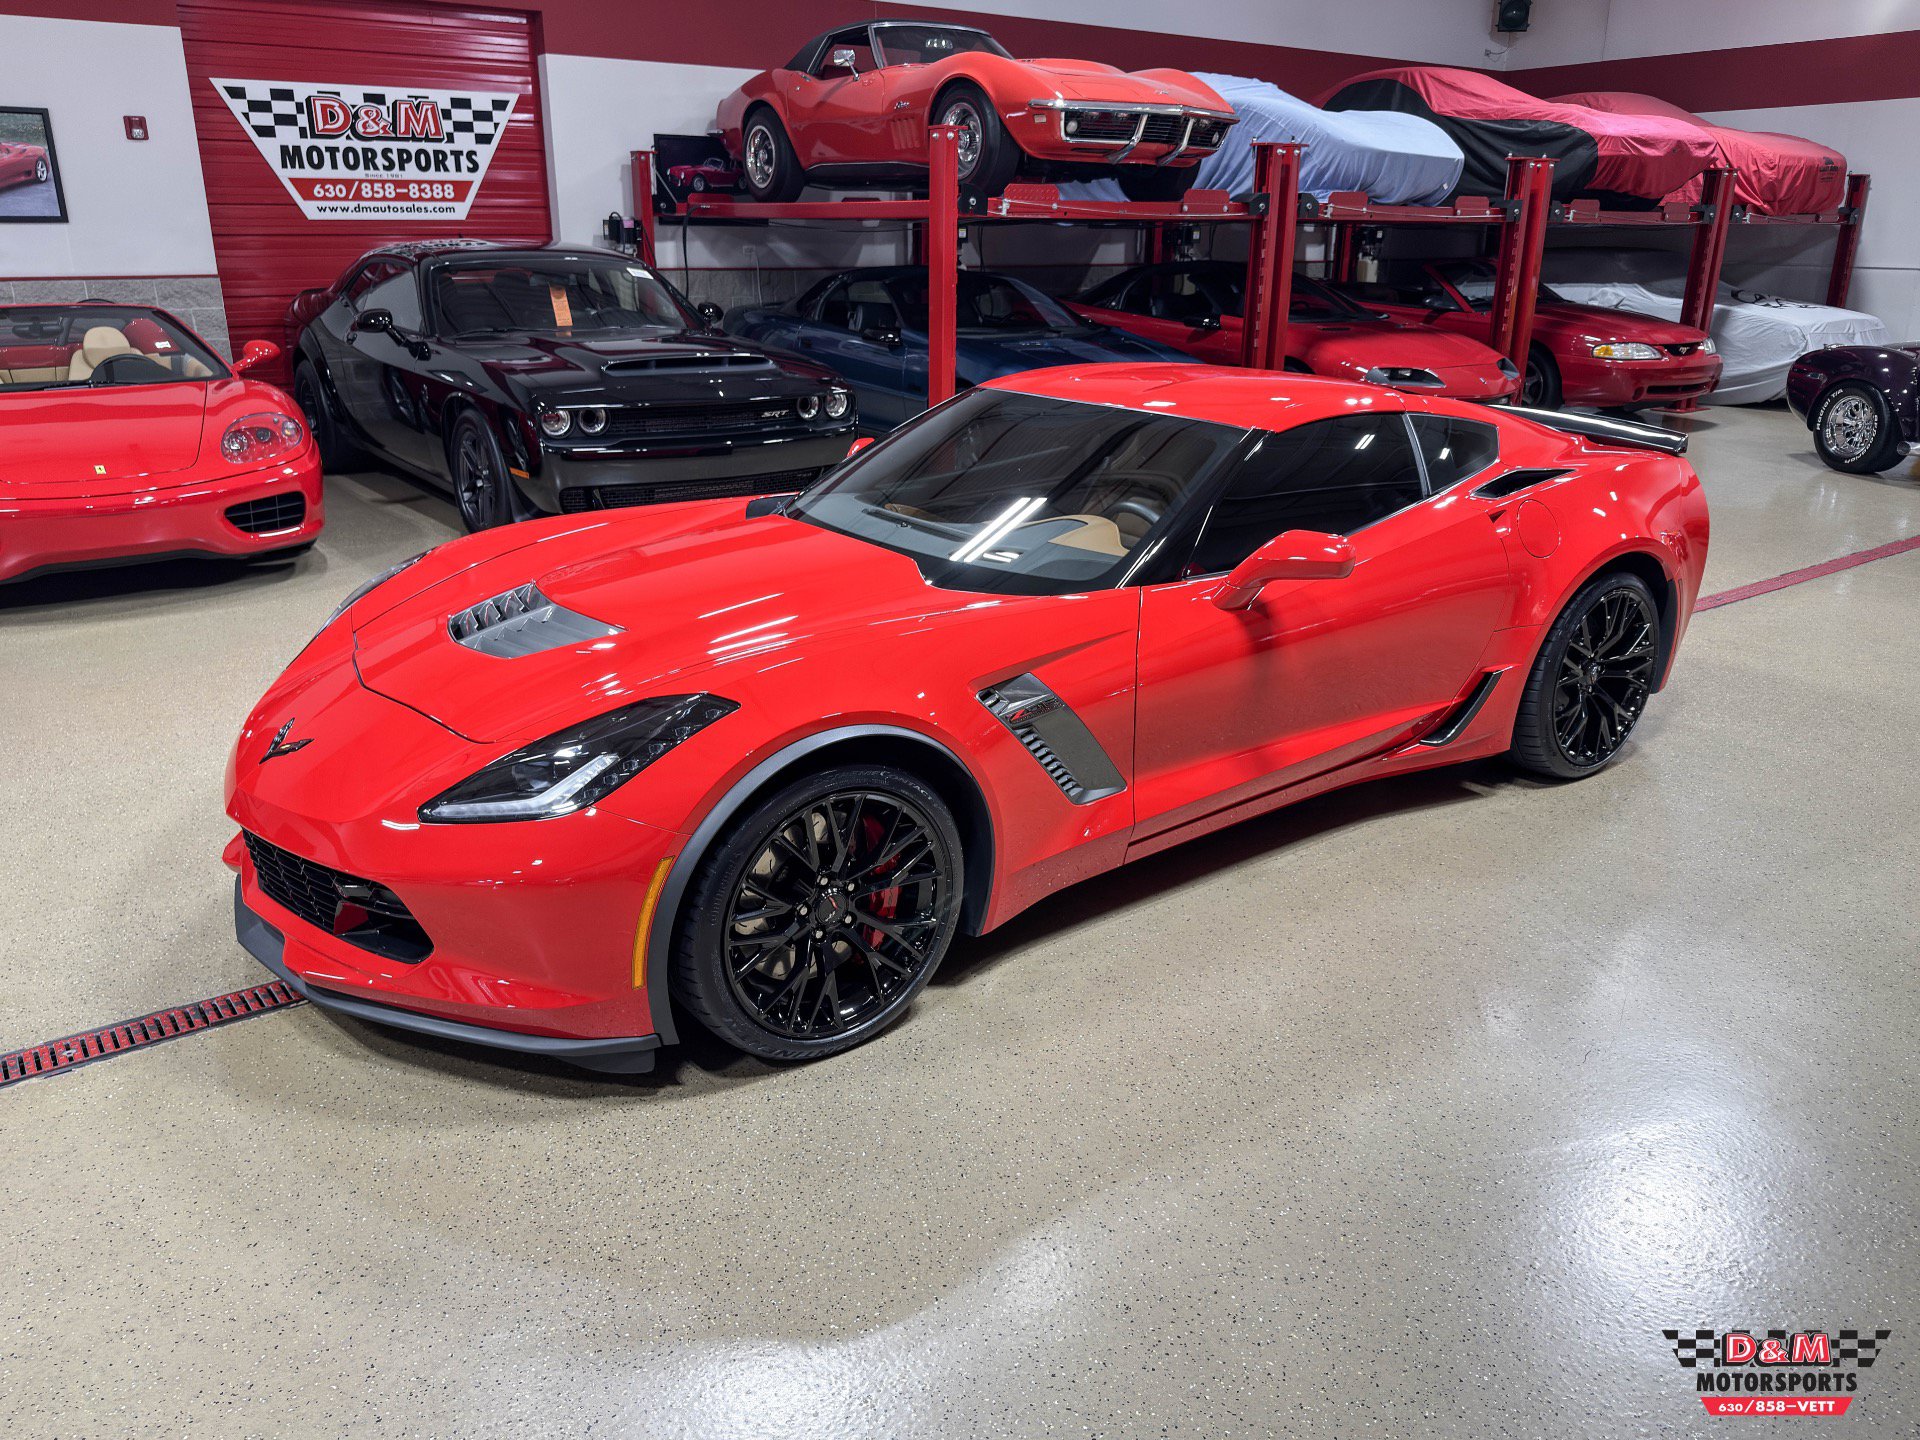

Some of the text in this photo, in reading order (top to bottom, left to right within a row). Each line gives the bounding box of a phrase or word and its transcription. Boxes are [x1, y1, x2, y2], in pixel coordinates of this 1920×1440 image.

[307, 95, 446, 143] D&M
[280, 144, 480, 173] MOTORSPORTS
[313, 181, 455, 199] 630/858-8388
[317, 203, 456, 214] www.dmautosales.com
[761, 409, 790, 418] SRT
